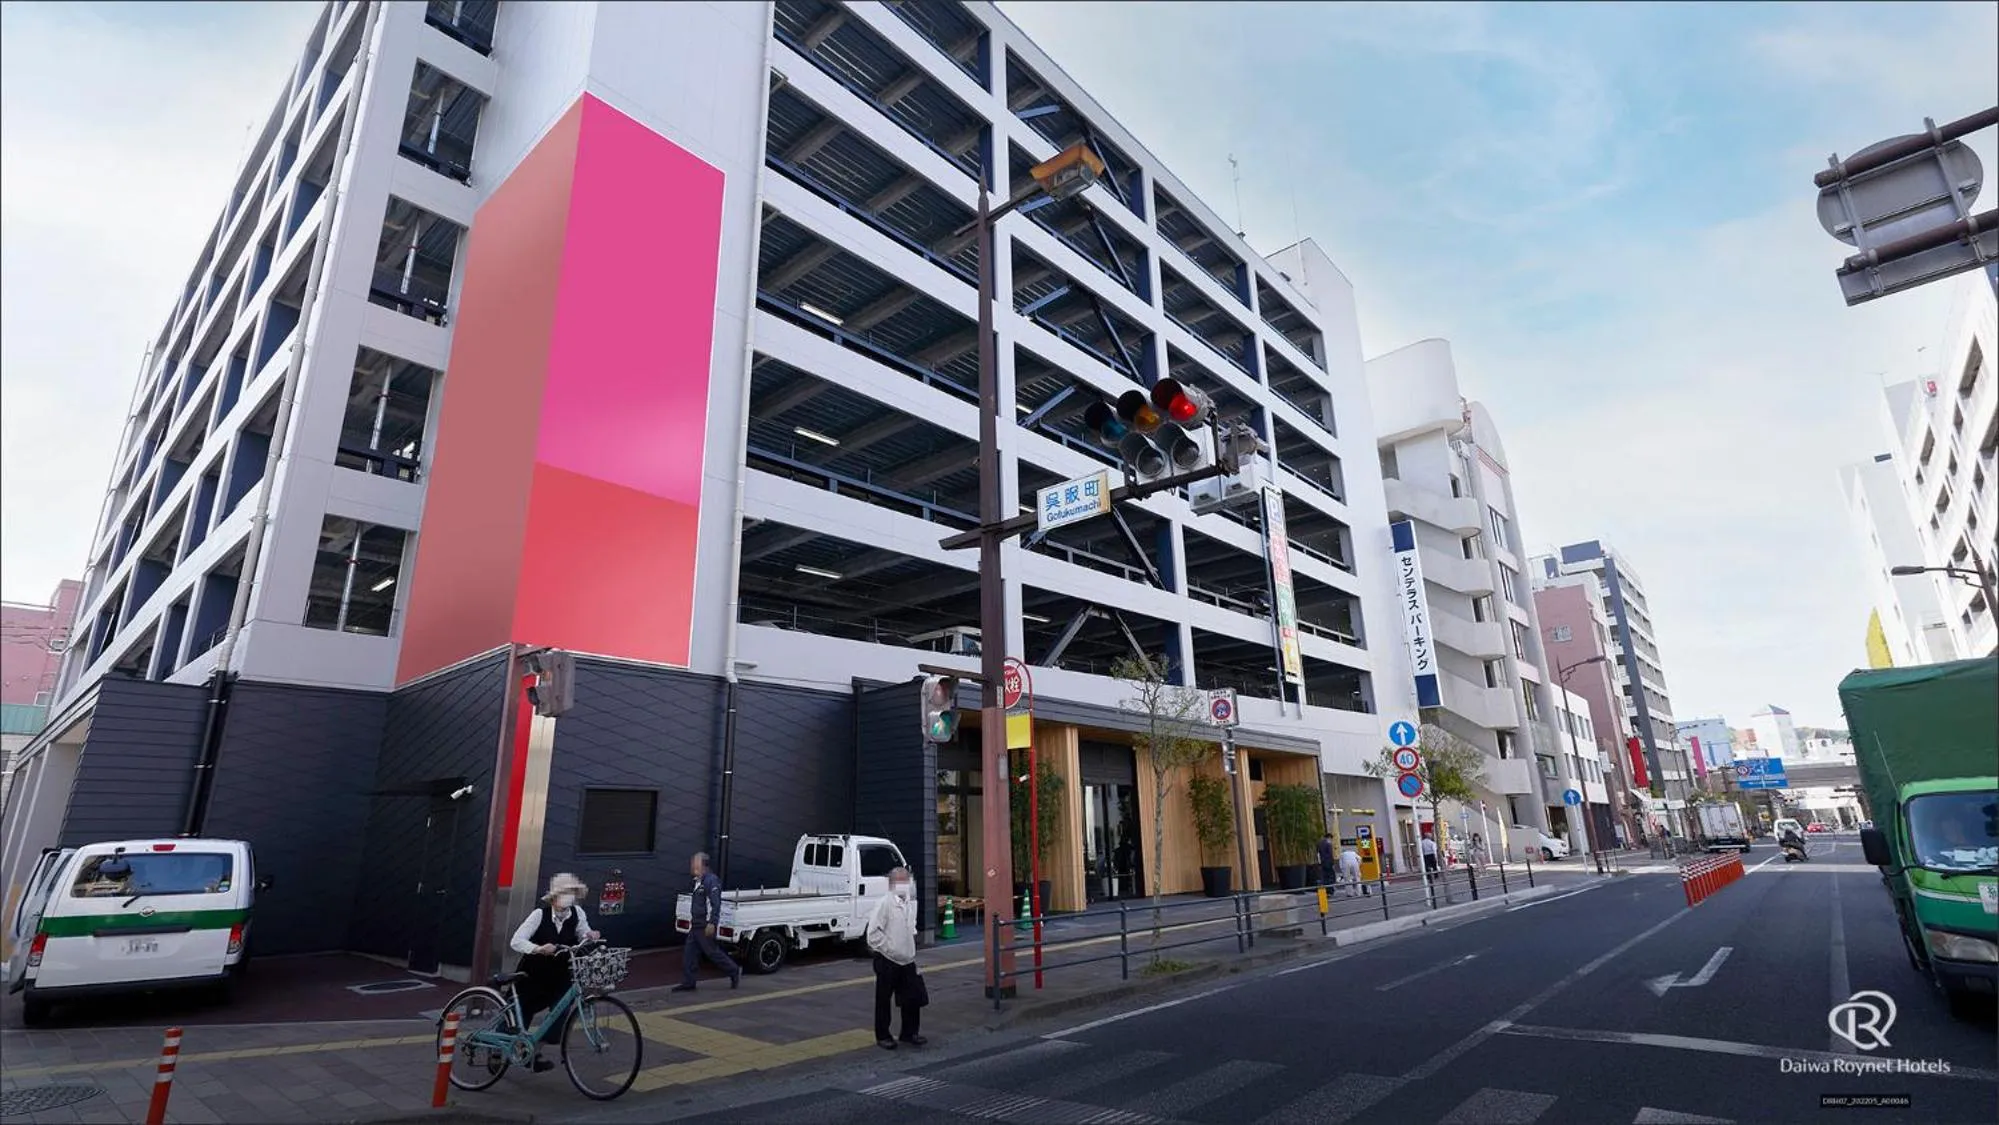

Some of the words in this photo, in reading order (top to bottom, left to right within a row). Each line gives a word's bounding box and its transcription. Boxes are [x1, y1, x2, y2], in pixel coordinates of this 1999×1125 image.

[1046, 480, 1100, 511] 呉服町
[1047, 497, 1101, 521] Gofukumachi
[1005, 675, 1021, 694] 火栓
[1400, 752, 1414, 765] 40
[1357, 827, 1370, 839] P
